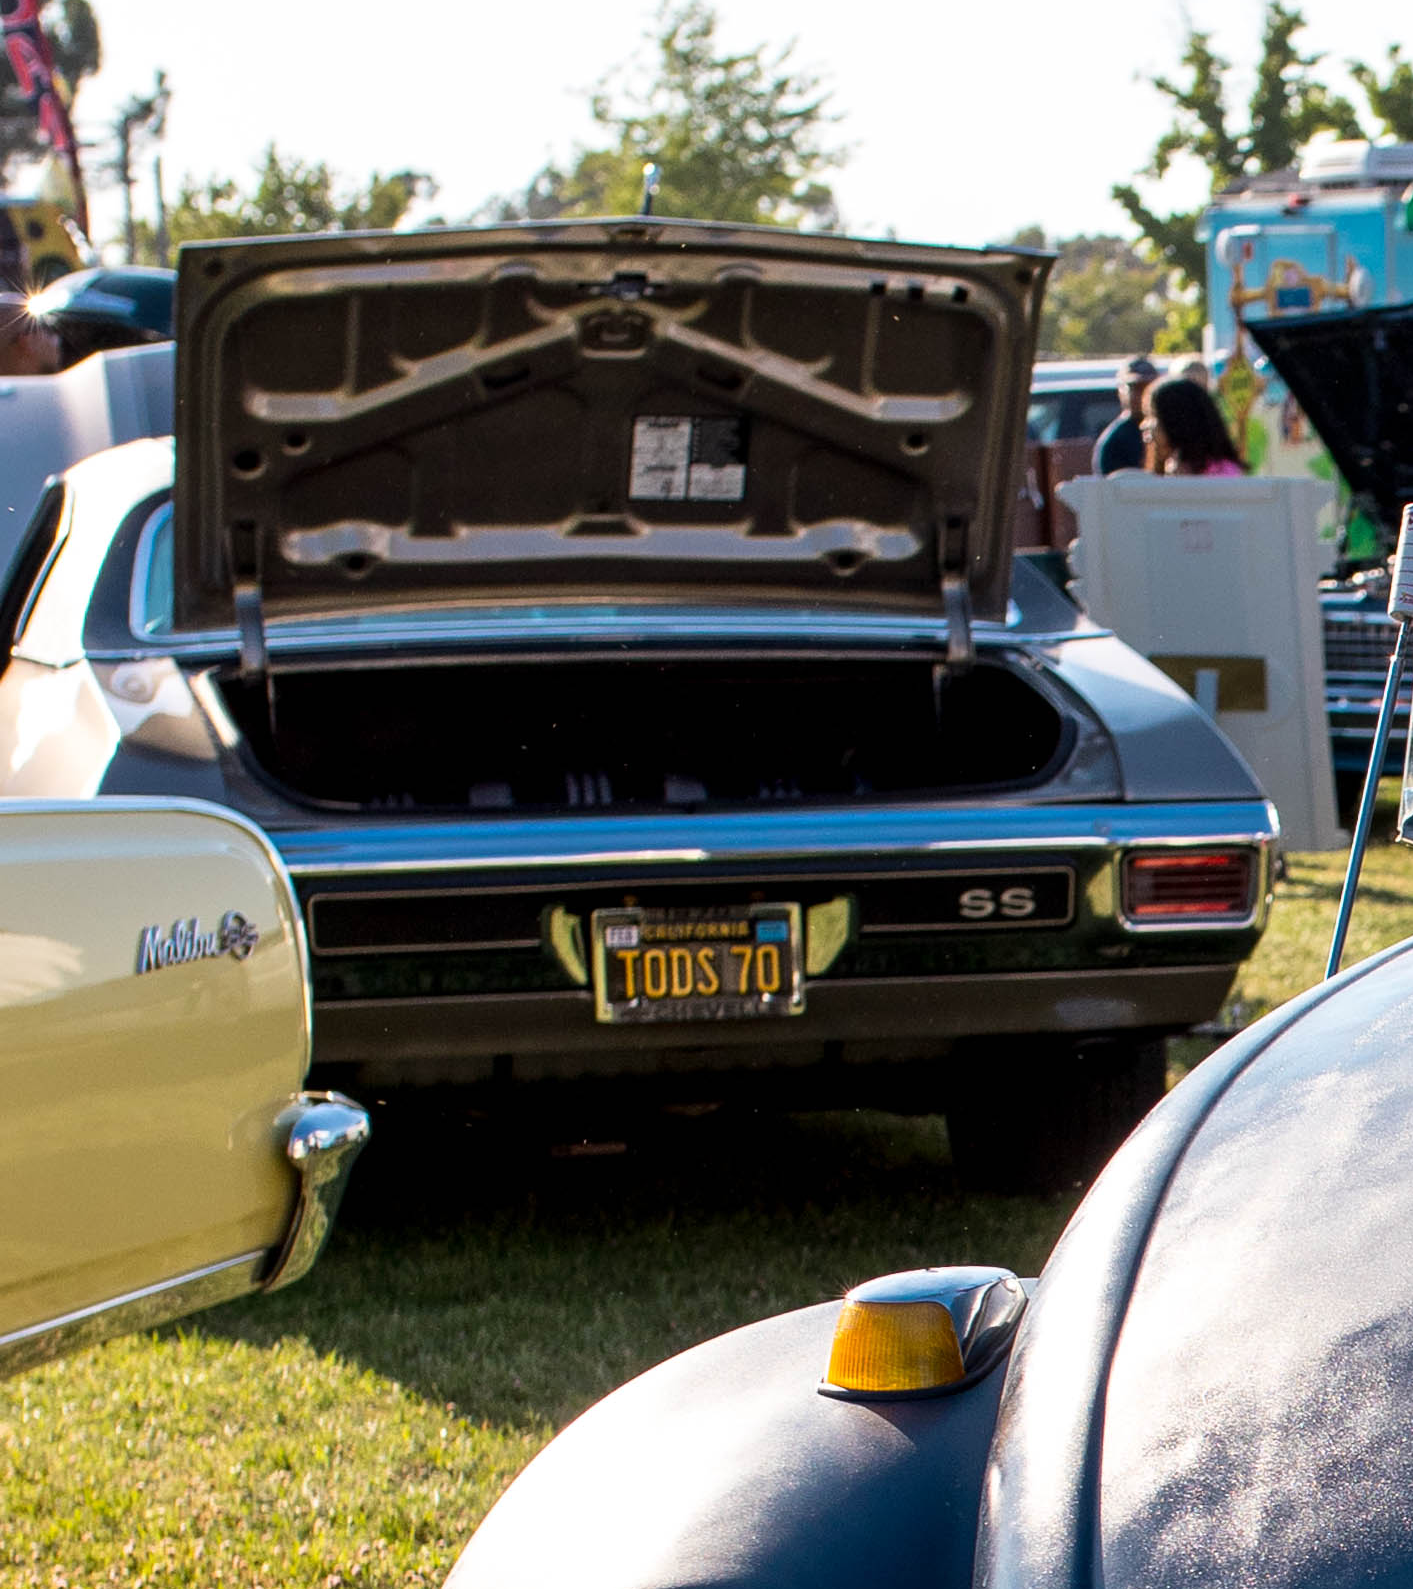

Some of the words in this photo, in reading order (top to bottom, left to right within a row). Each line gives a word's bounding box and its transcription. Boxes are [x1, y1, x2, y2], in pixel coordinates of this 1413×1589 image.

[959, 888, 1036, 918] SS
[135, 916, 220, 975] Malibu
[616, 947, 720, 999] TODS
[730, 944, 781, 995] 70
